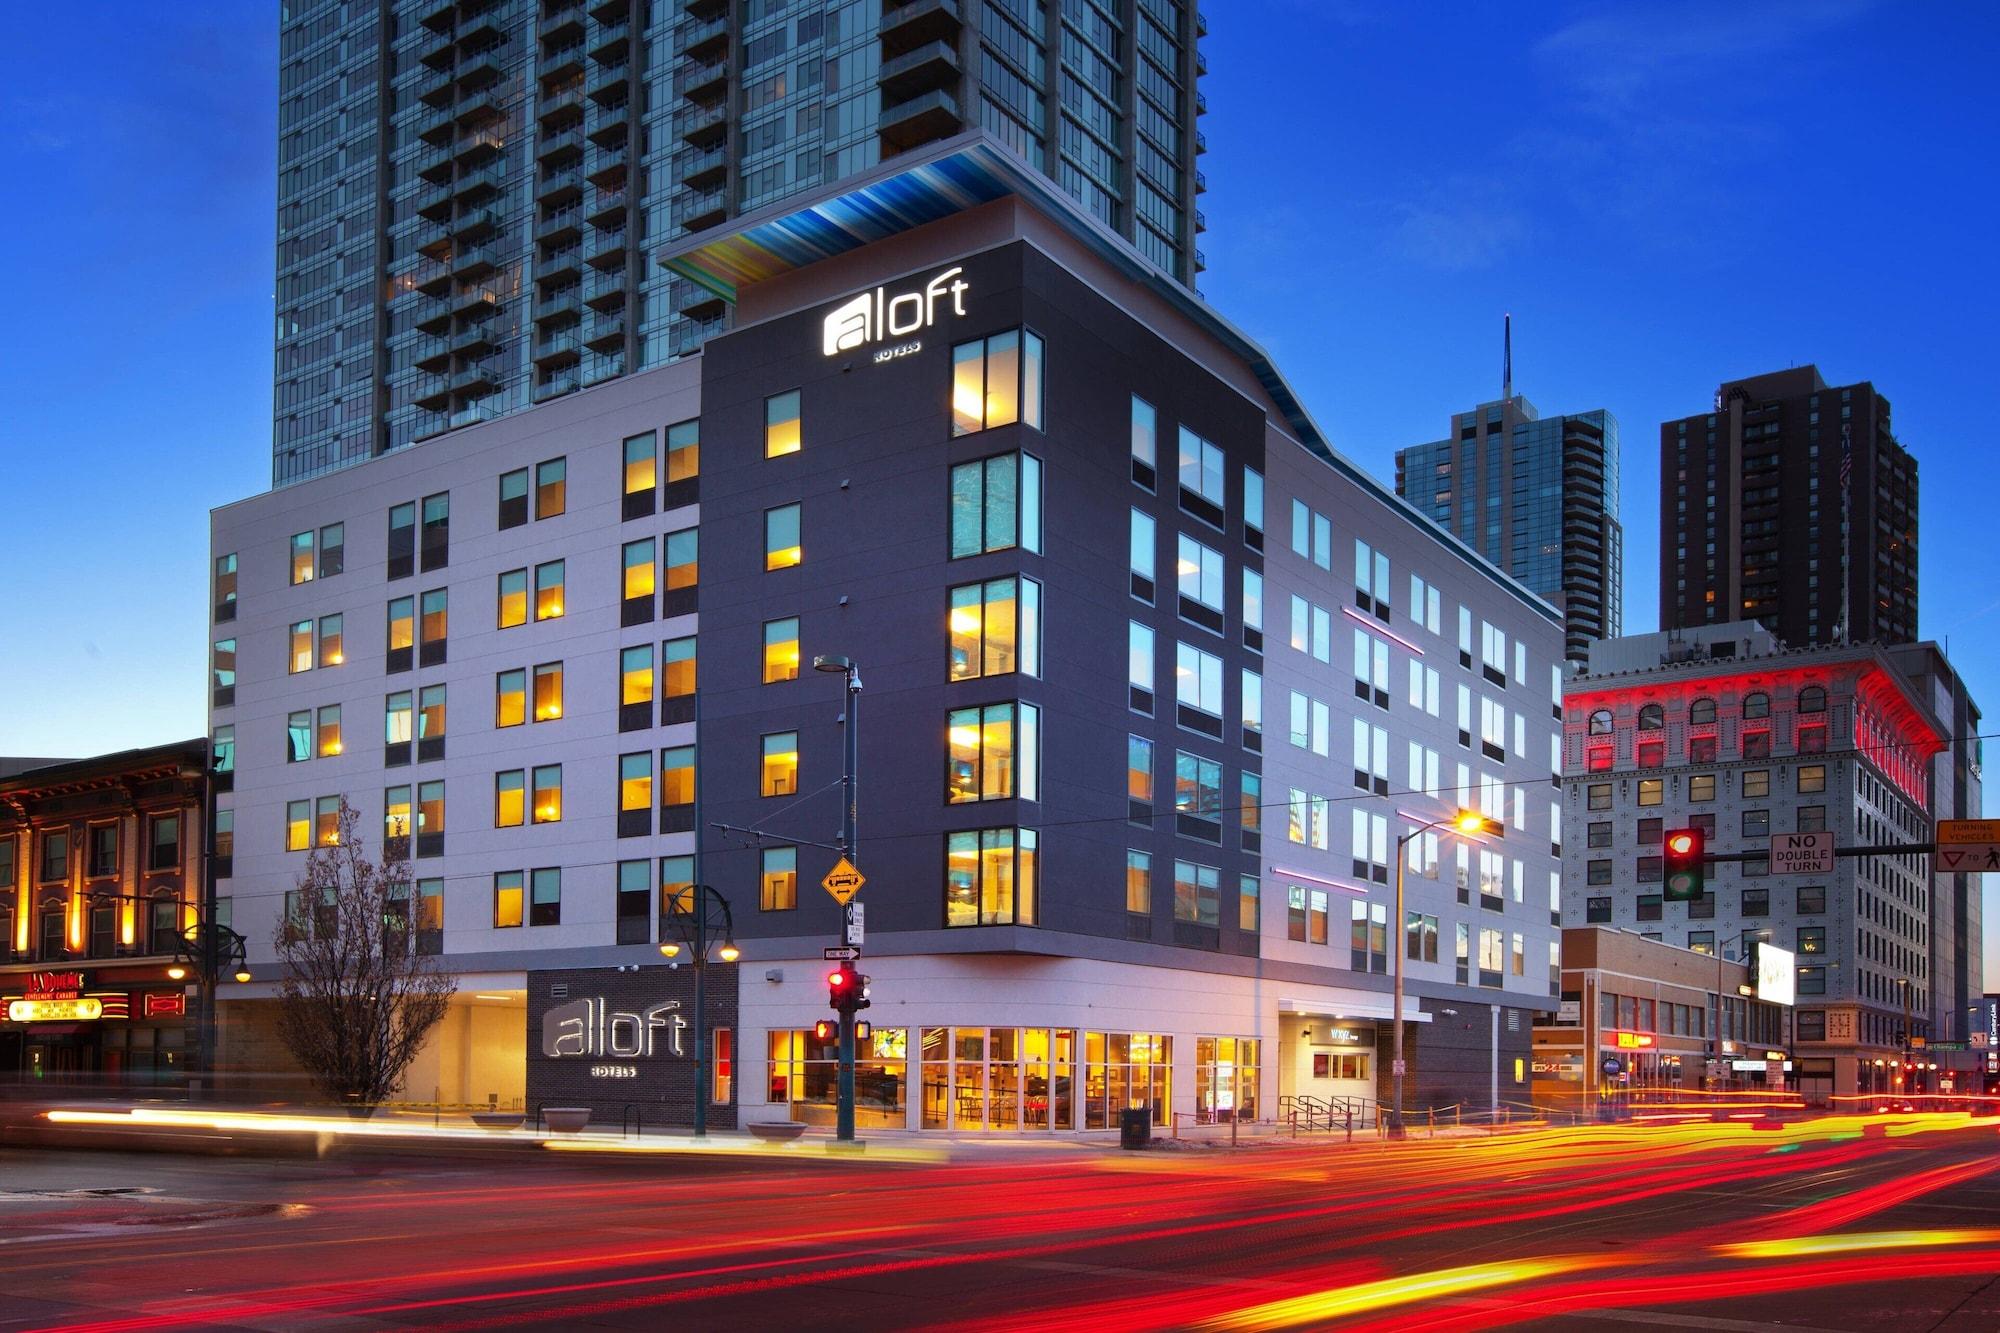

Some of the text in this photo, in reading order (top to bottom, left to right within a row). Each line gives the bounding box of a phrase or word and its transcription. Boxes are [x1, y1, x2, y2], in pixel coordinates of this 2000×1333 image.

[823, 267, 968, 356] aloft
[875, 342, 921, 362] HOTELS
[1953, 823, 1993, 831] TURNING
[1788, 835, 1816, 848] NO
[1776, 850, 1828, 861] DOUBLE
[1784, 861, 1821, 871] TURN
[542, 997, 687, 1057] aloft
[591, 1065, 637, 1077] HOTELS
